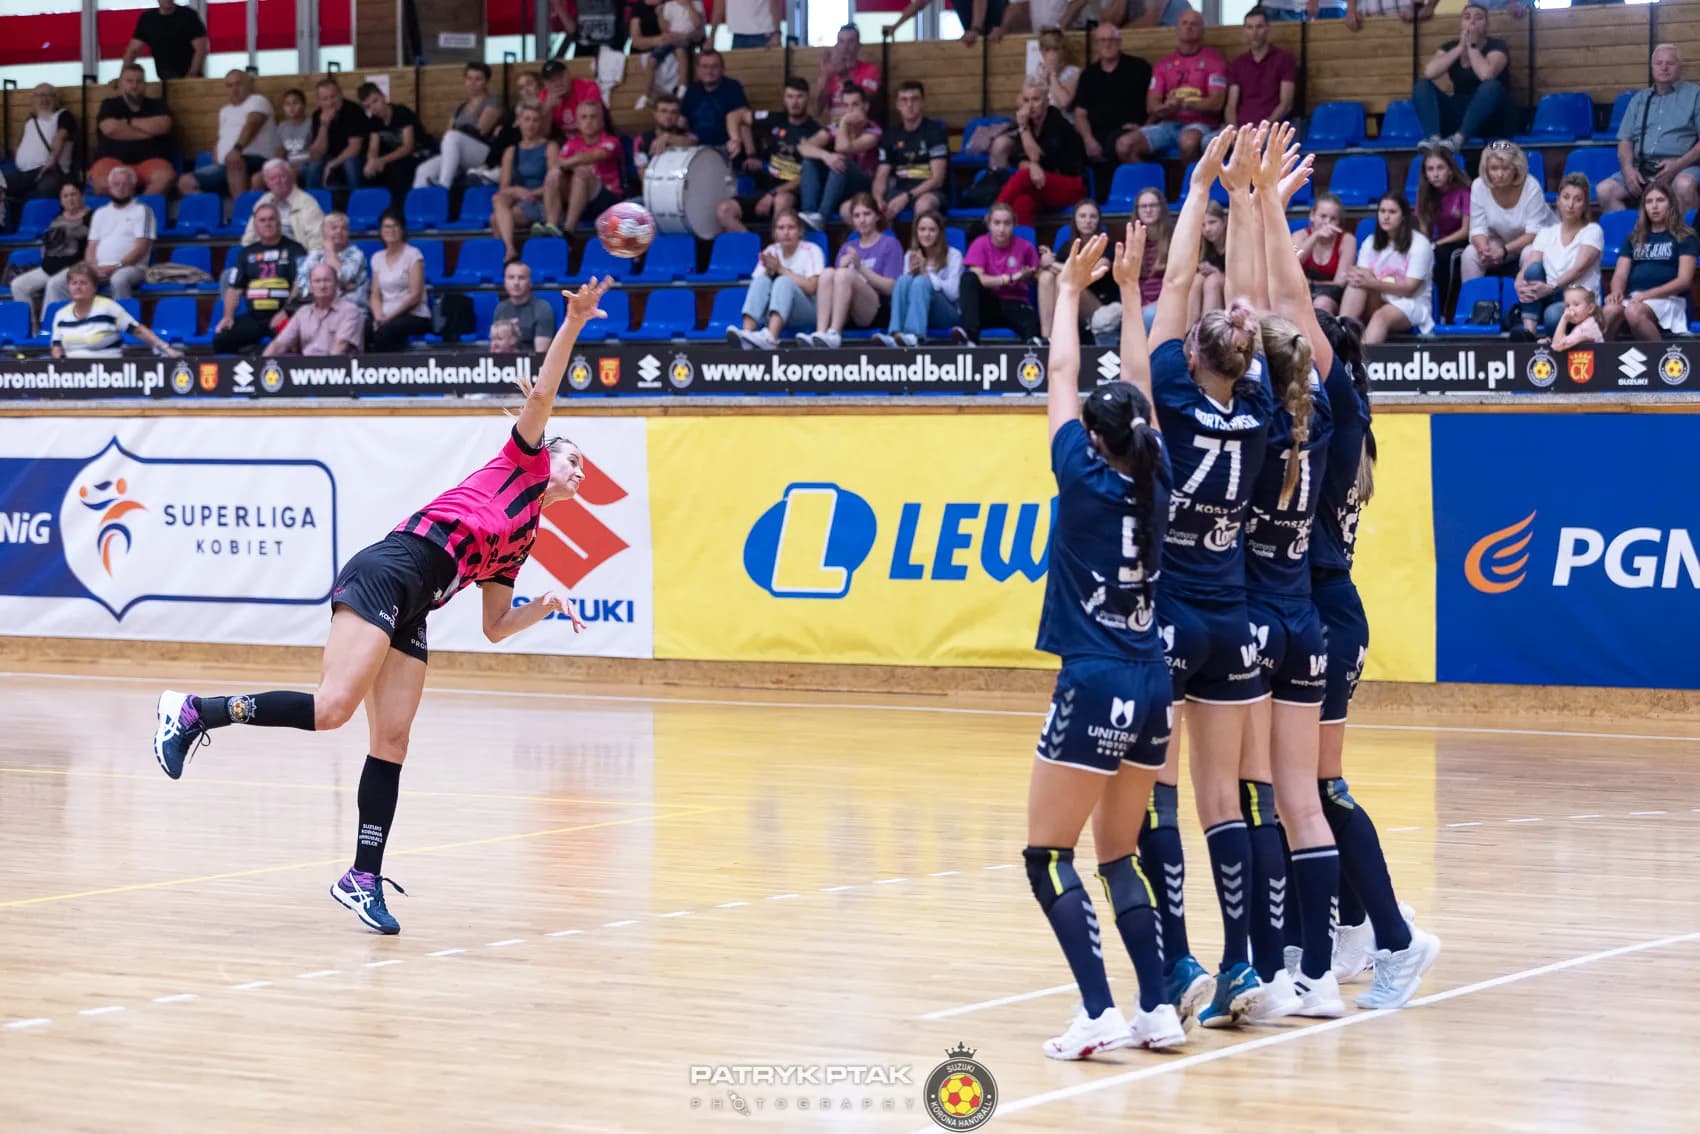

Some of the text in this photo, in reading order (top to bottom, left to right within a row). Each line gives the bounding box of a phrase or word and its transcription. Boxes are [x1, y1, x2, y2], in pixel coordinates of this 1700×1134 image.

[0, 362, 165, 396] ronahandball.pl
[290, 357, 545, 386] www.koronahandball.
[701, 354, 1008, 390] www.koronahandball.pl
[1361, 350, 1515, 389] andball.pl
[1617, 378, 1648, 386] SUZUKI
[1182, 434, 1241, 500] 71
[164, 504, 317, 529] SUPERLIGA
[196, 539, 284, 556] KOBIET
[411, 638, 428, 650] PRO
